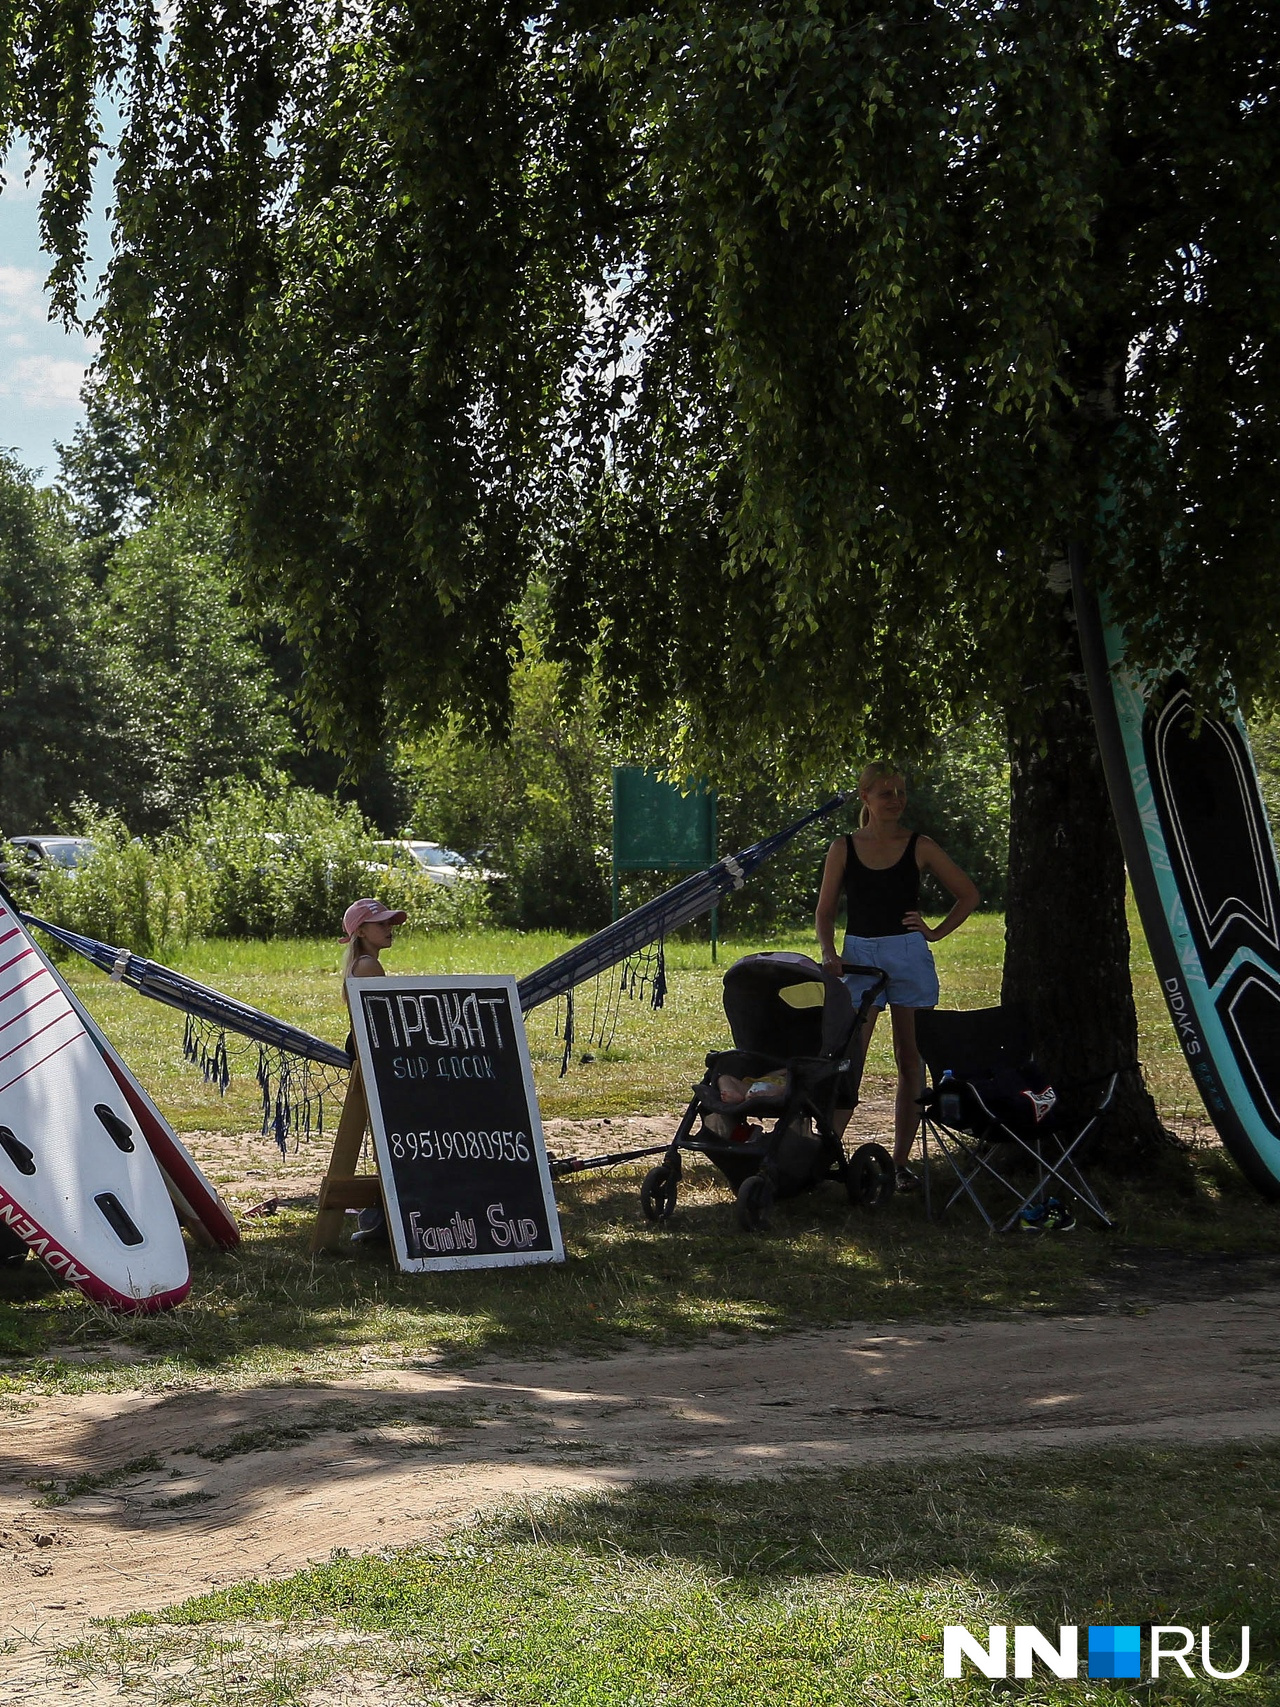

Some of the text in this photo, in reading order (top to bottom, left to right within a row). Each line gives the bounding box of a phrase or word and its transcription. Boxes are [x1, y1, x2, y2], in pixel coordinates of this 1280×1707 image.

[363, 991, 505, 1050] ПРОКАТ
[1164, 977, 1201, 1055] DIDAK'S
[393, 1055, 496, 1082] SUP ДОСОК
[391, 1130, 531, 1162] 89519080956
[409, 1202, 538, 1252] Family Sup
